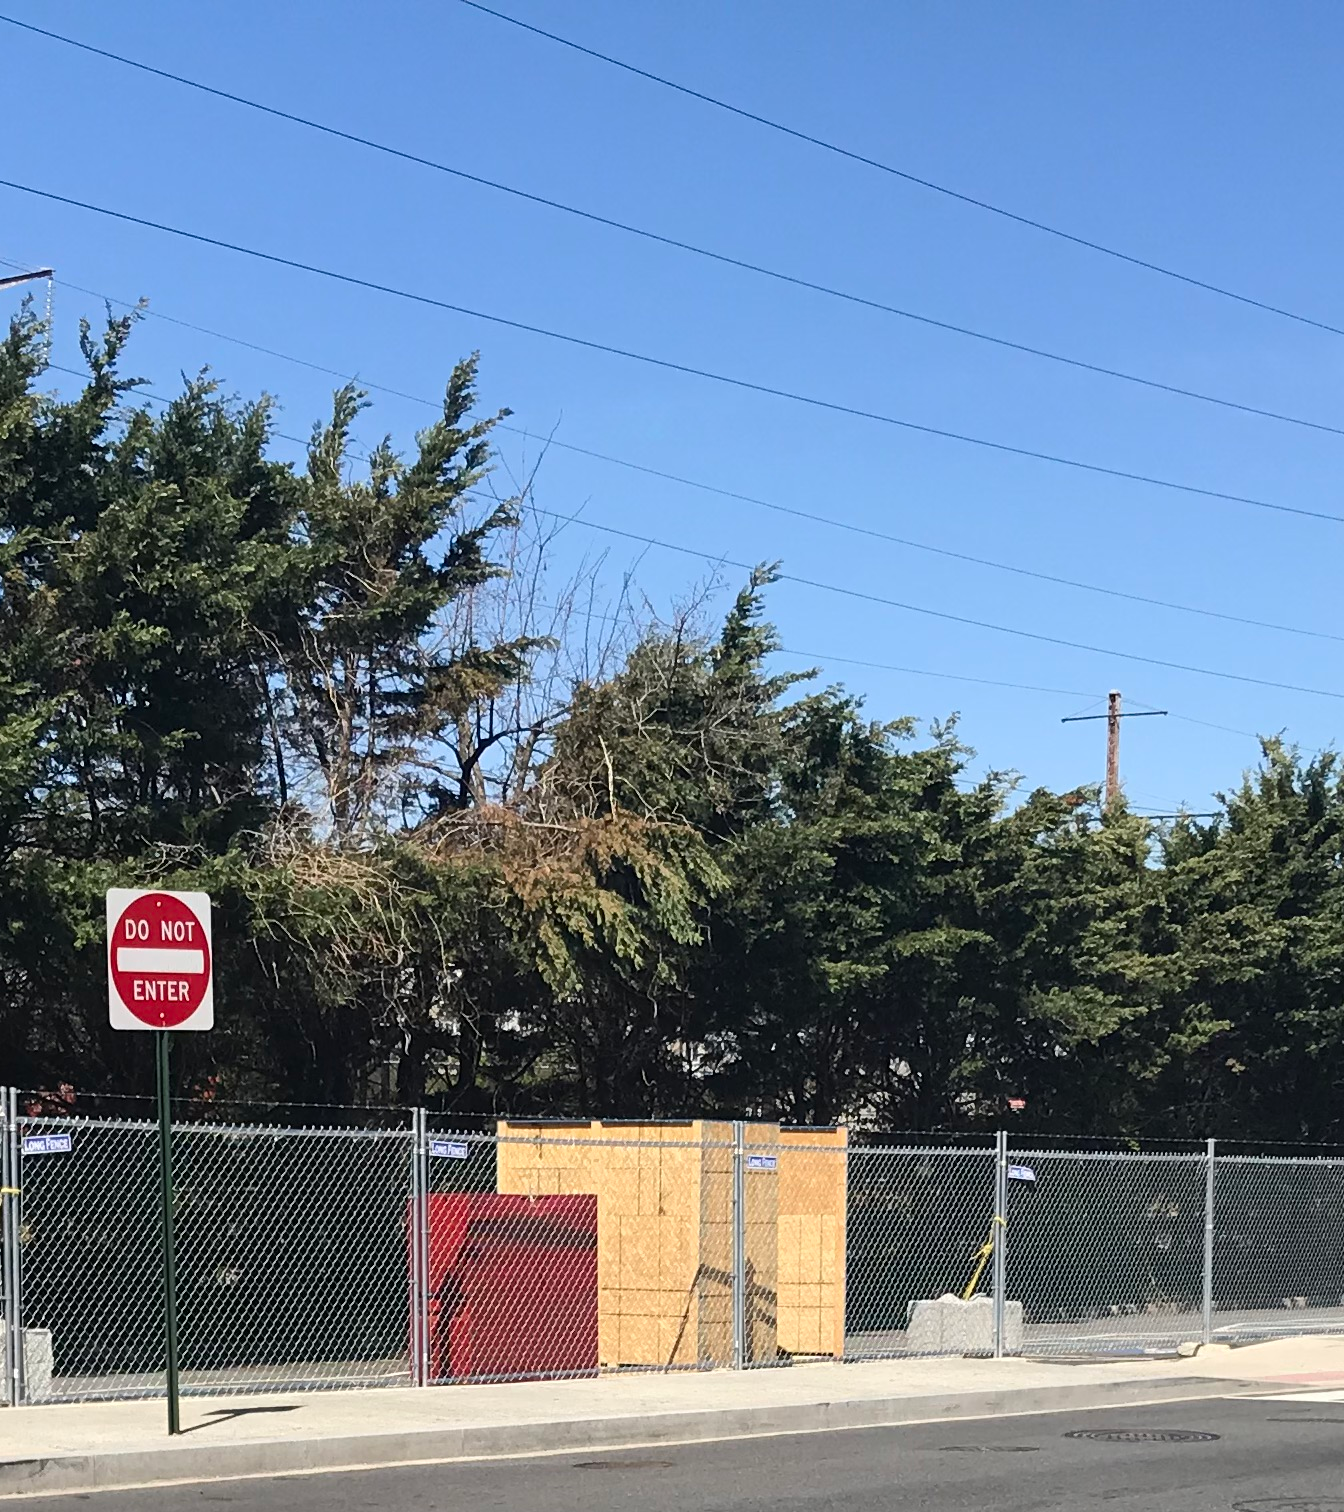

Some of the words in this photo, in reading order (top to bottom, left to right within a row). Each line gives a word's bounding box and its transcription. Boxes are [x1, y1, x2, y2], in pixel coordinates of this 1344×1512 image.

[125, 919, 149, 940] DO
[161, 921, 195, 941] NOT
[133, 980, 190, 1001] ENTER
[24, 1140, 45, 1151] LONG
[46, 1138, 69, 1150] FENCE
